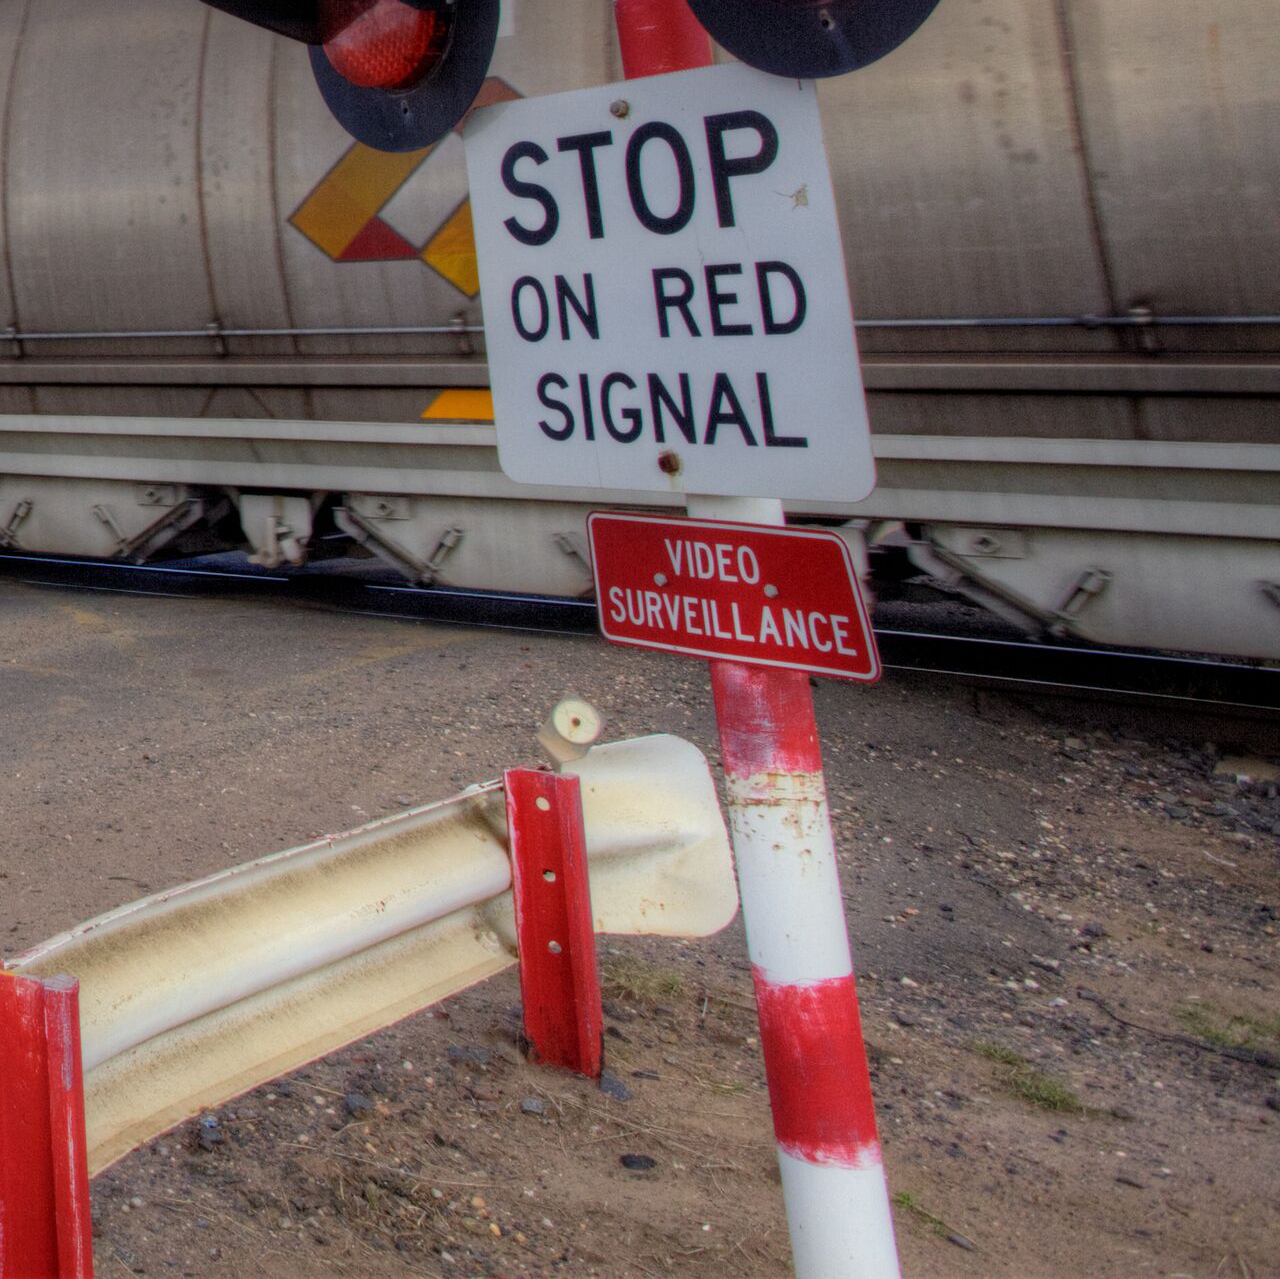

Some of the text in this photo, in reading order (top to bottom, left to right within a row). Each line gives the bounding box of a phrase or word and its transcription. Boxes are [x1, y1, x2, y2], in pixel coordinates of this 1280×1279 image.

[501, 110, 779, 246] STOP
[510, 260, 806, 342] ON RED
[536, 371, 808, 449] SIGNAL
[663, 537, 759, 585] VIDEO
[608, 588, 856, 656] SURVEILLANCE
